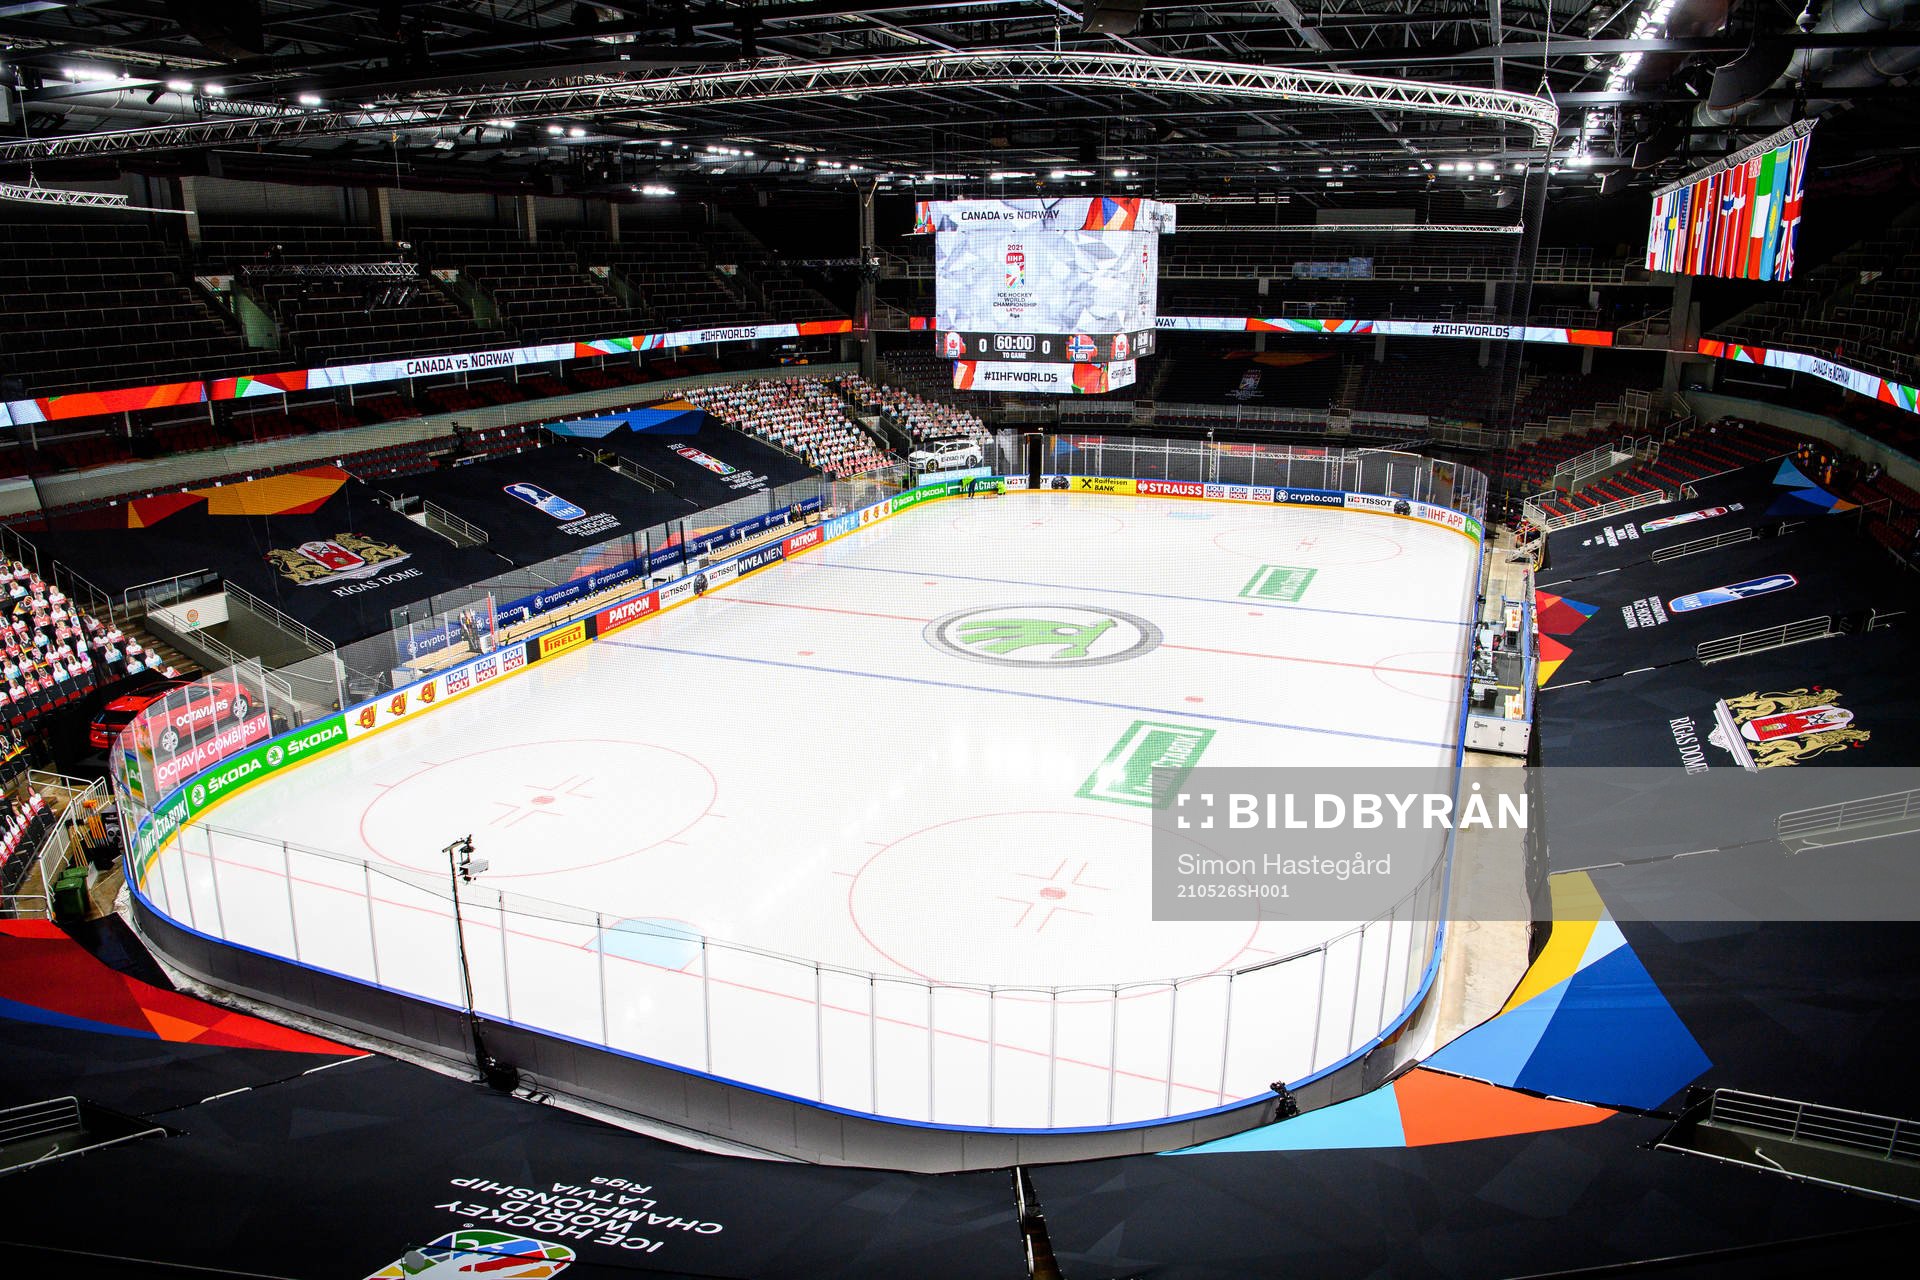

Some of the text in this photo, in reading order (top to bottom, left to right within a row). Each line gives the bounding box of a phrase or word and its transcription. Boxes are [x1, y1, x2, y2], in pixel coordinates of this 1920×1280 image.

[961, 211, 1000, 221] CANADA
[1017, 210, 1060, 220] NORWAY
[1007, 254, 1023, 262] IIHF
[699, 328, 756, 342] #IIHFWORLDS
[1432, 323, 1510, 338] #IIHFWORLDS
[978, 338, 987, 353] 0
[996, 335, 1032, 350] 60:00
[1042, 340, 1051, 354] 0
[407, 351, 514, 375] CANADA vs NORWAY
[983, 371, 1058, 383] #IIHFWORLDS
[1094, 477, 1128, 486] Raiffeisen
[1094, 484, 1115, 492] BANK
[1148, 483, 1203, 496] STRAUSS
[1290, 493, 1342, 506] crypto.com
[1360, 496, 1392, 507] TISSOT
[553, 506, 576, 517] IIHF
[1428, 507, 1463, 527] IIHF APP
[826, 516, 849, 539] Wolt
[790, 530, 817, 550] PATRON
[650, 550, 679, 566] crypto.com
[739, 553, 763, 573] NIVEA
[763, 545, 783, 562] MEN
[378, 567, 424, 586] DOME
[596, 568, 629, 586] crypto.com
[718, 563, 737, 577] TISSOT
[544, 585, 580, 604] crypto.com
[669, 581, 692, 596] TISSOT
[609, 596, 650, 624] PATRON
[543, 625, 582, 653] PIRELLI
[503, 648, 523, 662] LIQUI
[475, 656, 497, 672] LIQUI
[504, 657, 524, 672] MOLY
[446, 668, 469, 684] LIQUI
[476, 667, 498, 683] MOLY
[447, 679, 470, 694] MOLY
[176, 699, 229, 727] OCTAVIA RS
[158, 749, 206, 780] OCTAVIA
[207, 729, 242, 757] COMBI
[243, 721, 257, 735] RS
[257, 715, 268, 729] iV
[287, 725, 344, 756] ŠKODA
[1677, 743, 1710, 776] DOME
[208, 758, 262, 795] ŠKODA
[592, 1176, 653, 1195] Riga
[551, 1182, 657, 1210] LATVIA
[450, 1177, 724, 1235] CHAMPIONSHIP
[500, 1202, 633, 1234] WORLD
[434, 1200, 665, 1254] ICE HOCKEY
